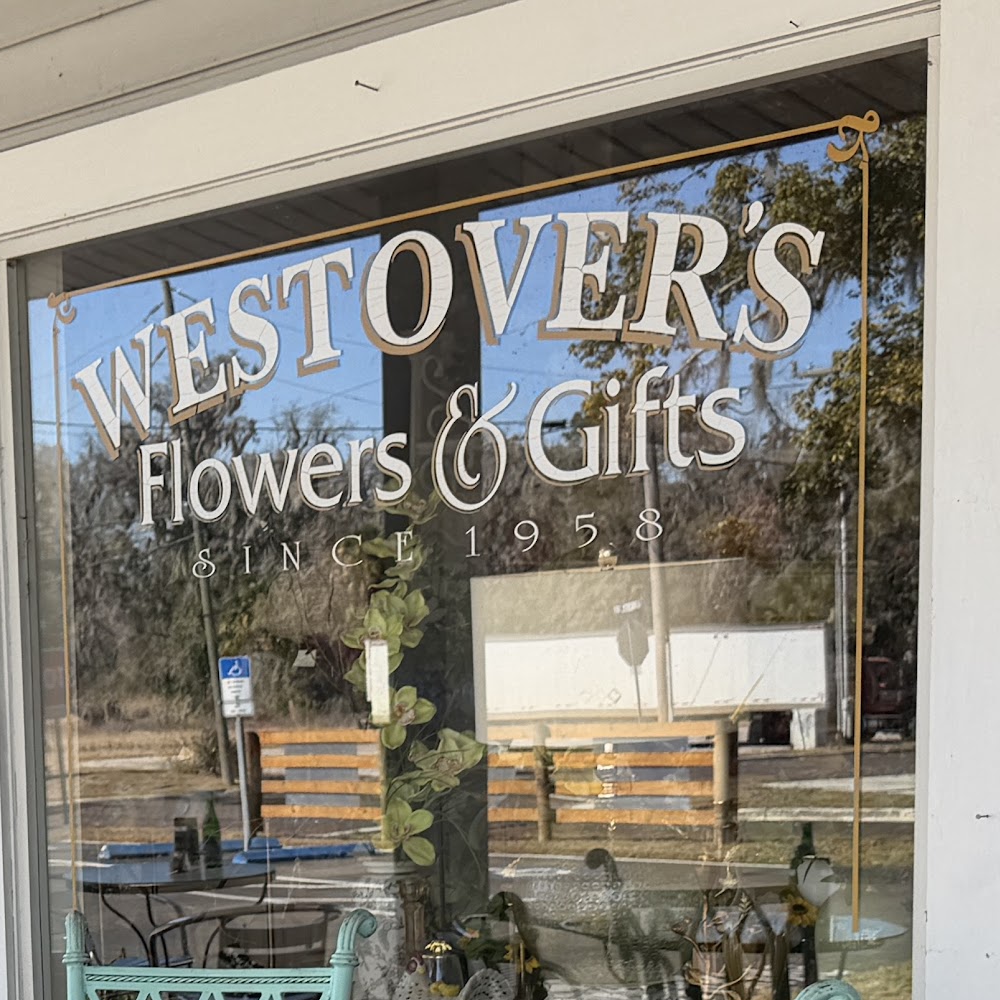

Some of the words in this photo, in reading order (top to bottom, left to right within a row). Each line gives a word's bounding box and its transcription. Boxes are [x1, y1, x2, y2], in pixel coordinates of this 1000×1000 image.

[72, 201, 825, 460] WESTOVER'S
[137, 432, 412, 526] Flowers
[431, 380, 518, 513] &
[526, 366, 747, 486] Gifts
[192, 530, 414, 578] SINCE
[464, 508, 664, 558] 1958
